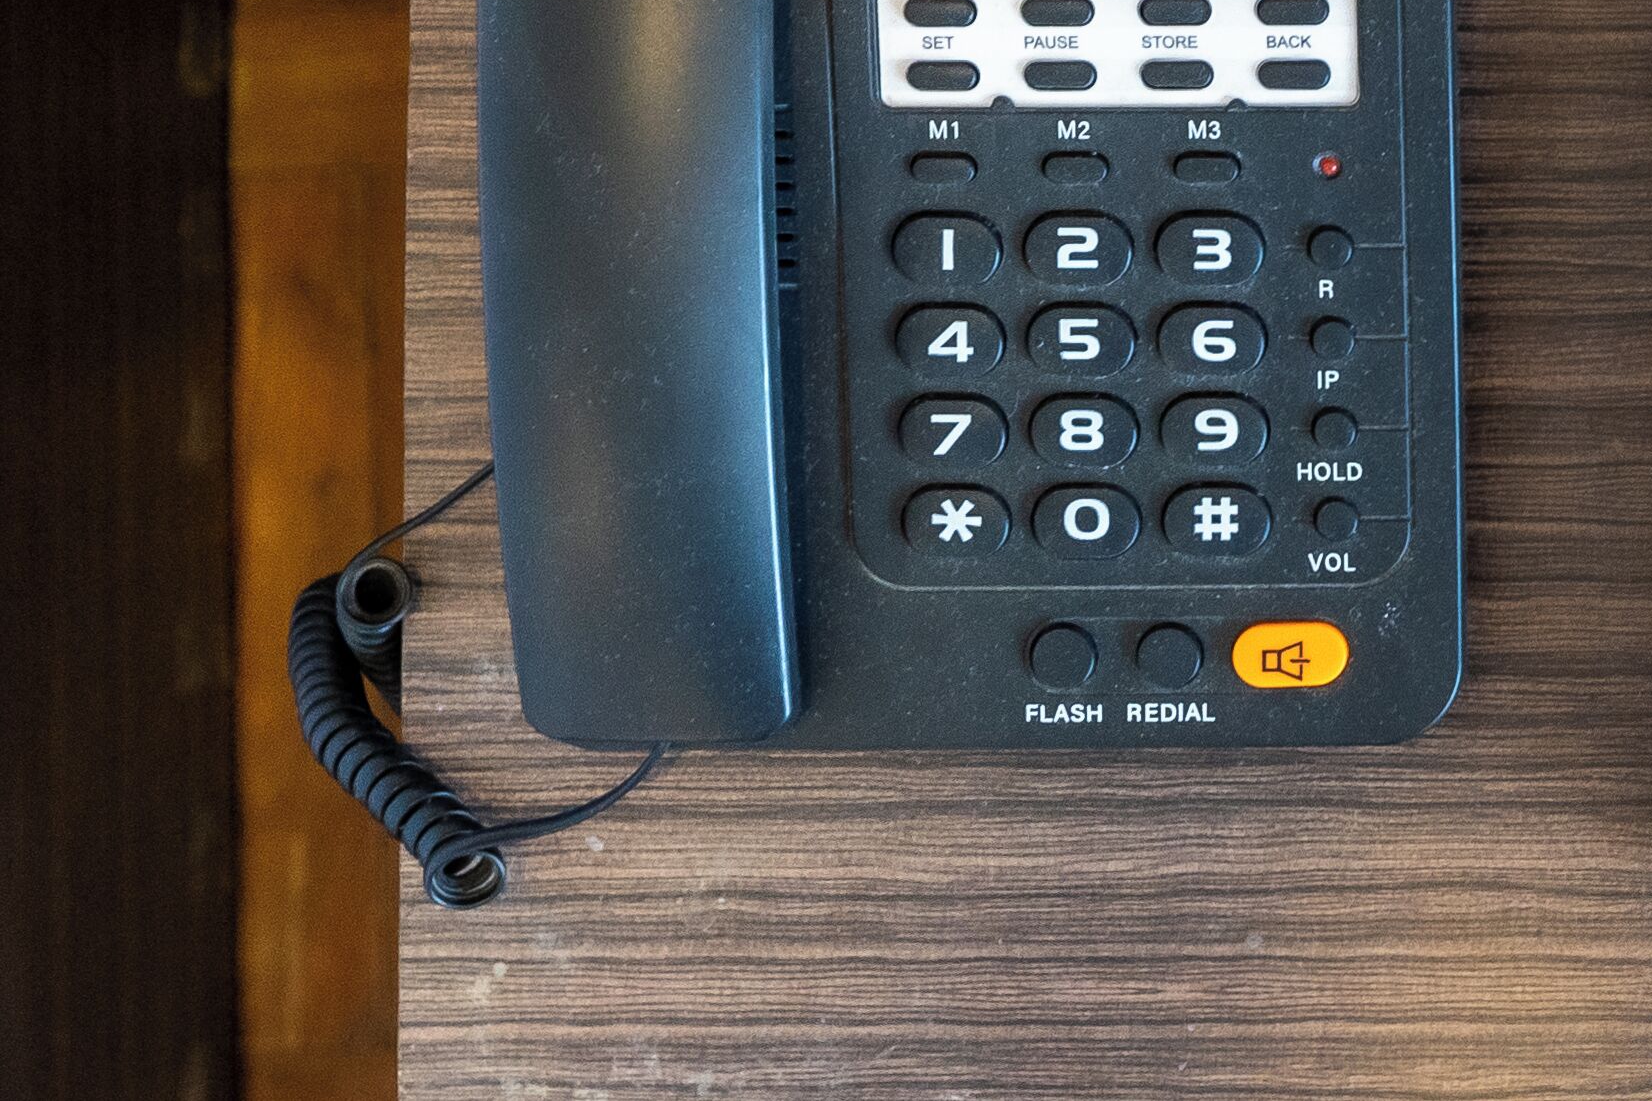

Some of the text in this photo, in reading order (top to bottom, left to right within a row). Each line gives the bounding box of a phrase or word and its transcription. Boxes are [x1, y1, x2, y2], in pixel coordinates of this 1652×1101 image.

[923, 36, 1311, 49] SET PAUSE STORE BACK
[930, 120, 1220, 139] M1 M2 M3
[943, 228, 1231, 270] 1 2 3
[1319, 280, 1333, 298] R
[928, 319, 1236, 362] 4 5 6
[1318, 371, 1339, 389] IP
[931, 410, 1238, 455] 7 8 9
[1297, 462, 1362, 481] HOLD
[1064, 497, 1238, 540] 0 #
[1308, 553, 1355, 572] VOL
[1026, 703, 1215, 722] FLASH REDIAL
